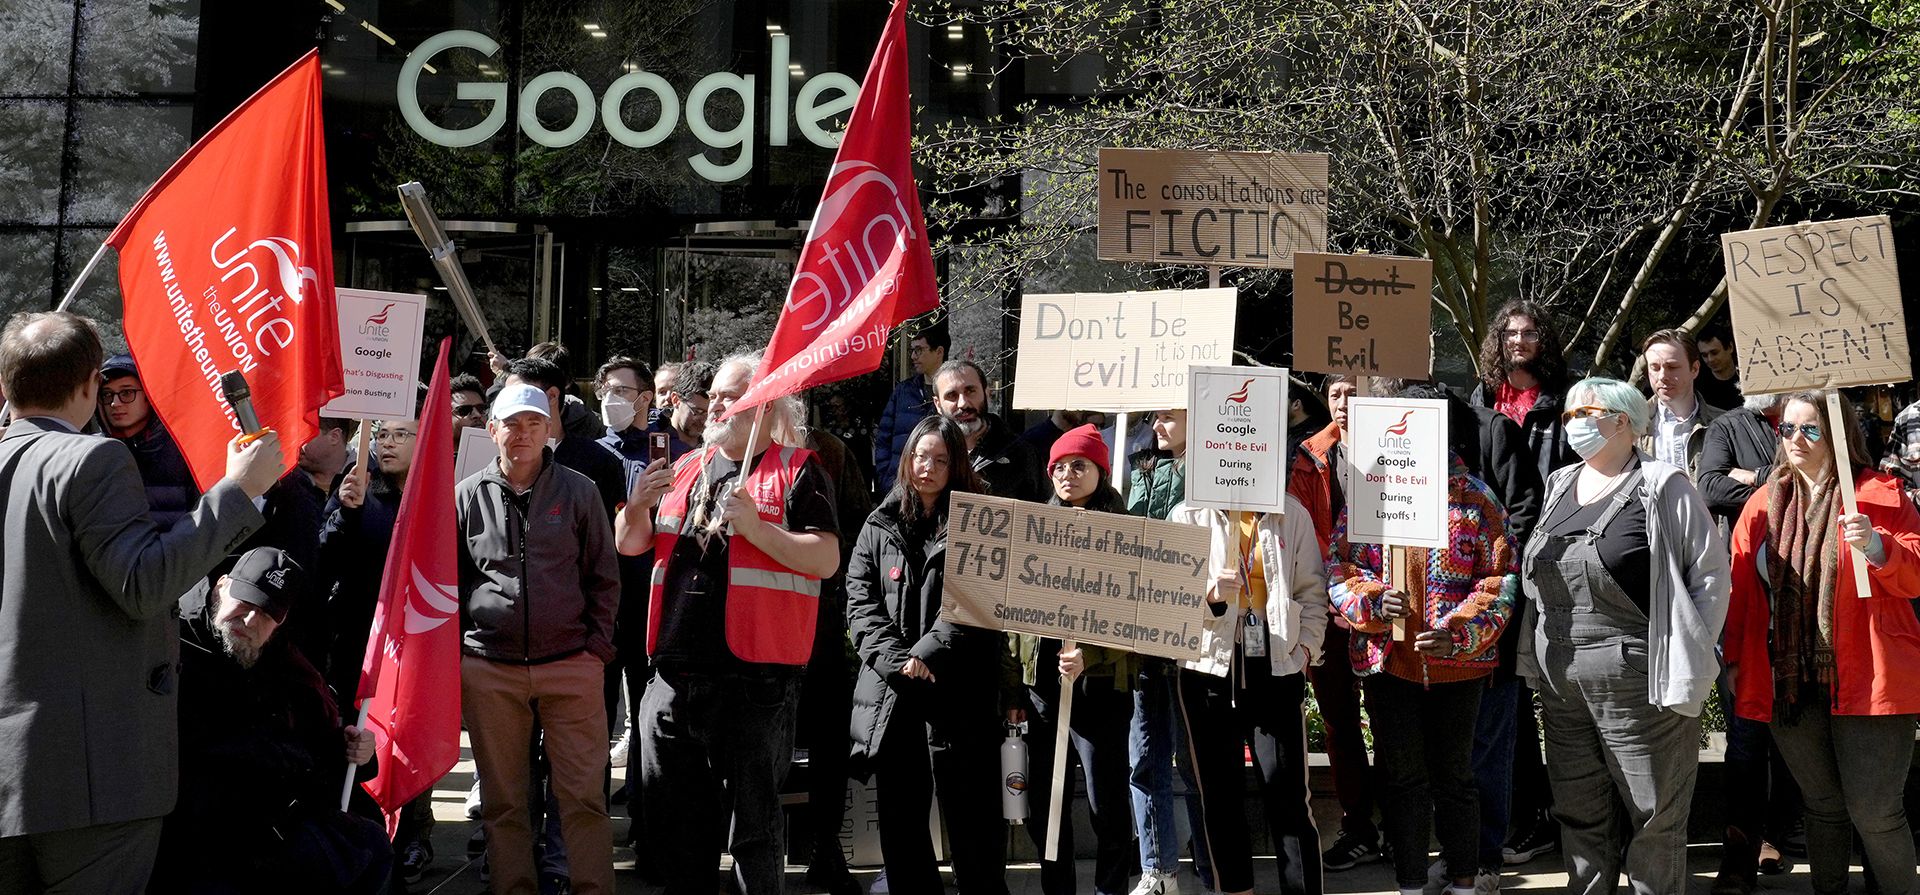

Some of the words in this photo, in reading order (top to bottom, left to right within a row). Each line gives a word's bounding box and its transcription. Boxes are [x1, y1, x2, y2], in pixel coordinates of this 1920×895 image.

[396, 29, 862, 182] Google
[1107, 168, 1147, 200] The
[1161, 175, 1294, 205] consultations
[1300, 188, 1326, 205] are
[1126, 208, 1323, 260] FICTION
[1728, 222, 1886, 282] RESPECT
[211, 226, 295, 357] unite
[1786, 277, 1841, 317] IS
[1034, 301, 1127, 341] Don't
[1150, 300, 1187, 338] be
[1338, 301, 1370, 331] Be
[359, 324, 390, 338] unite
[355, 346, 392, 359] Google
[1155, 342, 1168, 362] it
[1172, 342, 1185, 361] is
[1191, 339, 1222, 361] not
[1327, 336, 1379, 372] Evil
[1745, 321, 1894, 381] ABSENT
[365, 370, 404, 381] Disgusting
[1073, 346, 1141, 389] evil
[364, 390, 391, 399] Busting
[1218, 403, 1252, 417] unite
[1216, 423, 1257, 436] Google
[1205, 440, 1232, 451] Don't
[1235, 442, 1248, 451] Be
[1250, 442, 1267, 452] Evil
[1378, 436, 1412, 449] unite
[1219, 458, 1252, 471] During
[1376, 455, 1417, 469] Google
[1215, 476, 1249, 487] Layoffs
[1366, 473, 1393, 484] Don't
[1395, 475, 1408, 484] Be
[1410, 475, 1427, 485] Evil
[1380, 491, 1413, 505] During
[1376, 509, 1410, 521] Layoffs
[956, 502, 1011, 538] 7:02
[1025, 514, 1091, 550] Notified
[1095, 529, 1112, 551] of
[1113, 531, 1206, 577] Redundancy
[954, 541, 1007, 581] 7:49
[1018, 553, 1101, 595] Scheduled
[1105, 573, 1121, 599] to
[1126, 571, 1203, 609] Interview
[994, 602, 1056, 628] someone
[1057, 604, 1078, 630] for
[1082, 608, 1108, 635] the
[1112, 621, 1160, 644] same
[1163, 623, 1200, 651] role
